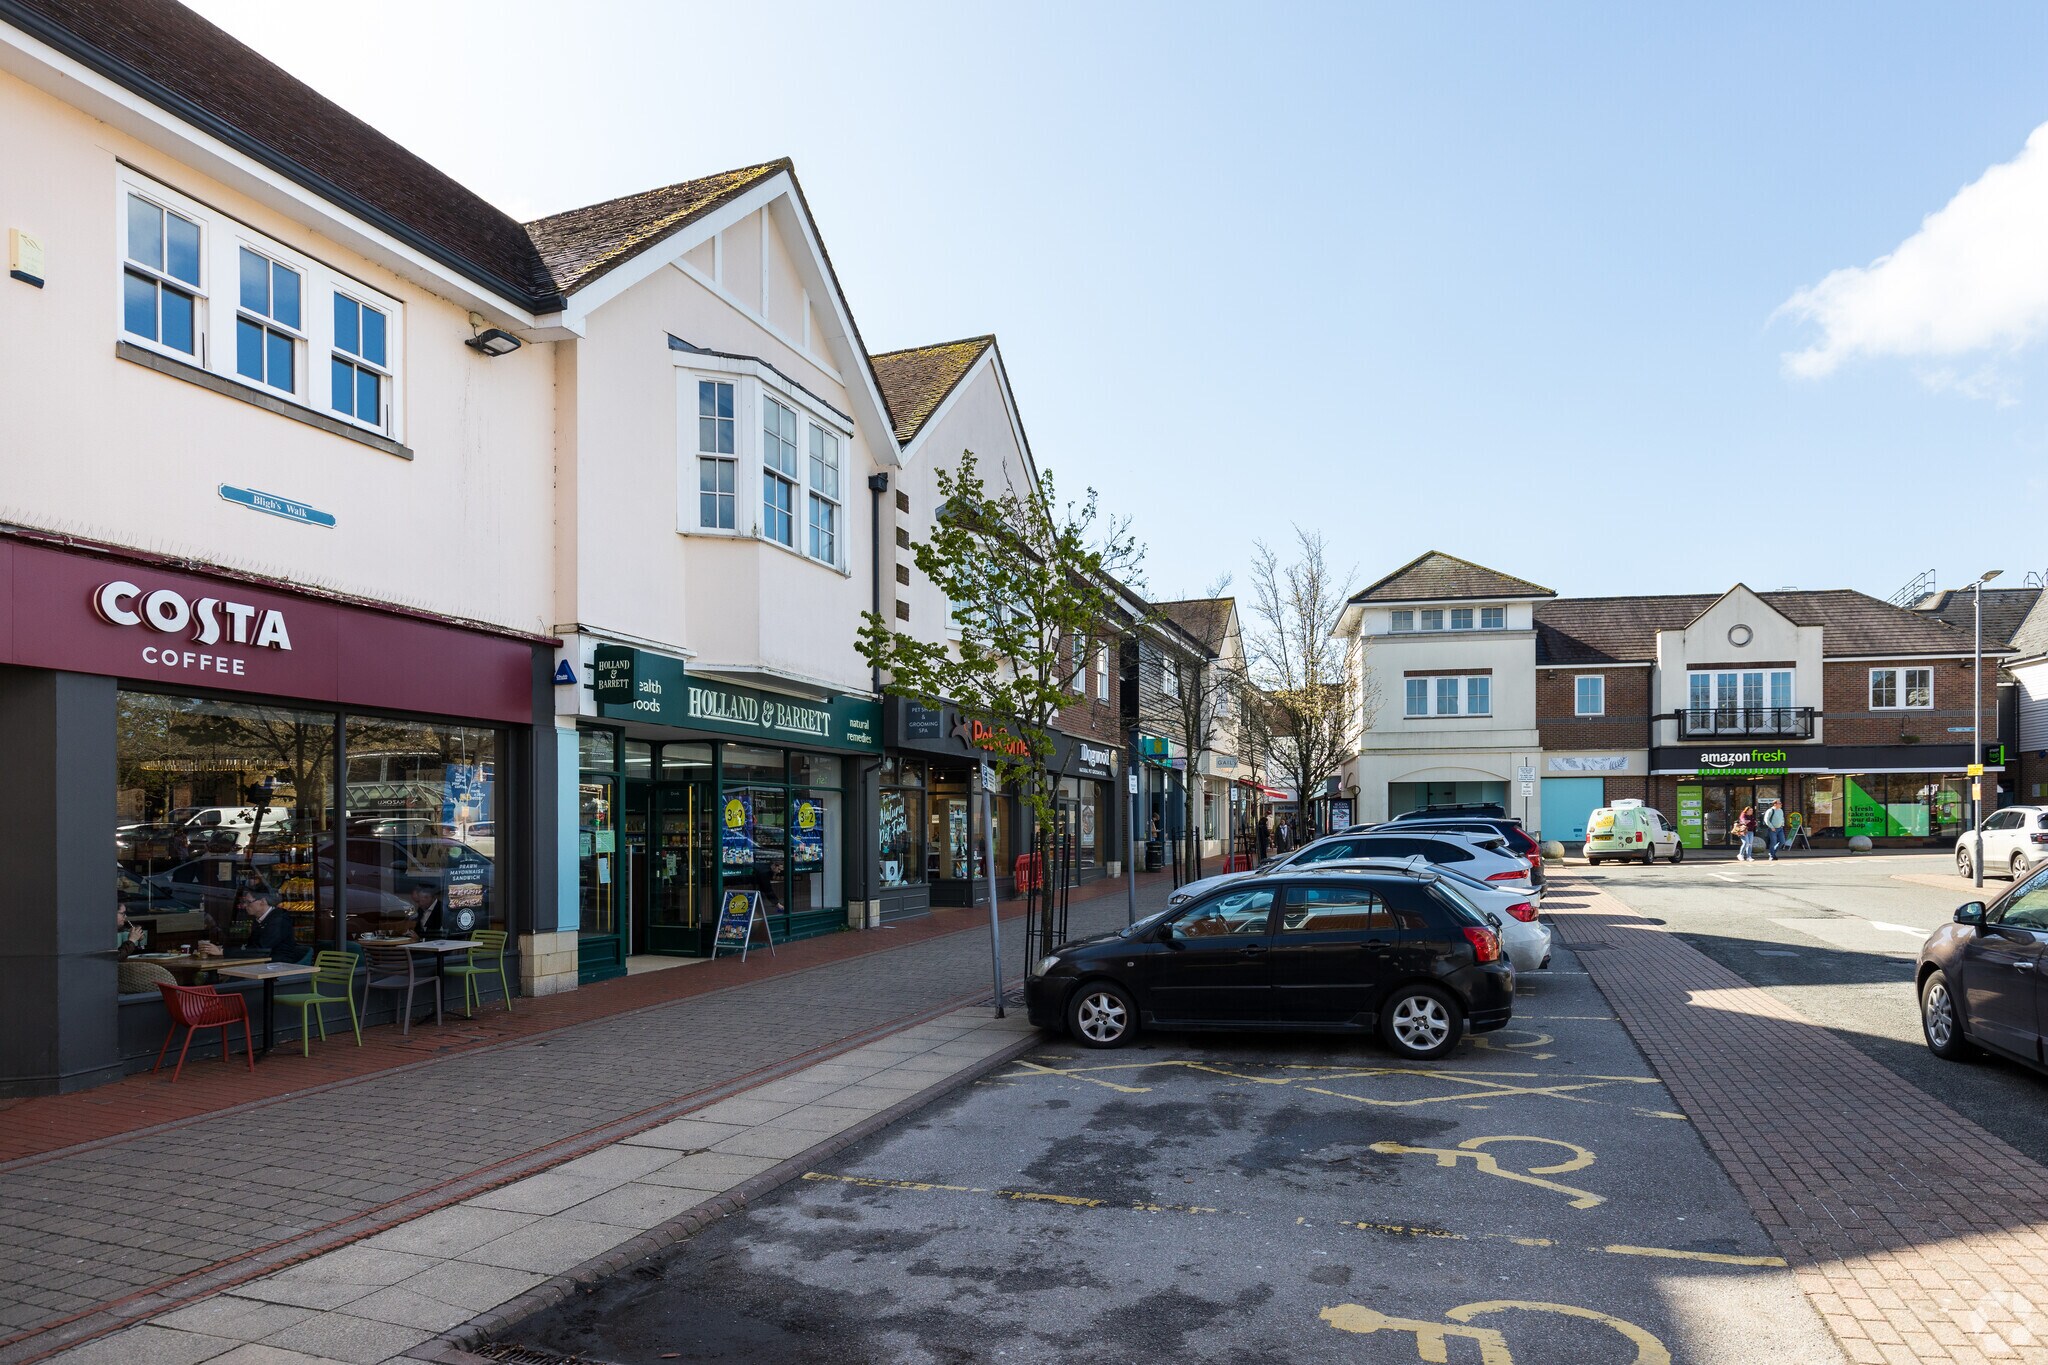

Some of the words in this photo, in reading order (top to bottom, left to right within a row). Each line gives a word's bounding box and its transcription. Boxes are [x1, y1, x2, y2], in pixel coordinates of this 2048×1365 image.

[253, 494, 282, 510] Bligh's
[286, 504, 308, 518] Walk
[97, 581, 292, 650] COSTA
[142, 646, 245, 676] COFFEE
[598, 660, 630, 671] HOLLAND
[610, 669, 618, 679] &
[598, 679, 629, 690] BARRETT
[639, 679, 662, 695] ealth
[687, 686, 758, 722] HOLLAND
[761, 700, 774, 728] &
[775, 702, 831, 737] BARRETT
[849, 719, 870, 730] natural
[846, 732, 872, 744] remedies
[1700, 753, 1751, 764] amazon
[1751, 749, 1786, 761] fresh
[727, 809, 733, 821] 3
[800, 811, 805, 823] 3
[809, 811, 814, 823] 2
[1866, 816, 1883, 824] daily
[730, 901, 736, 910] 3
[741, 901, 747, 910] 2
